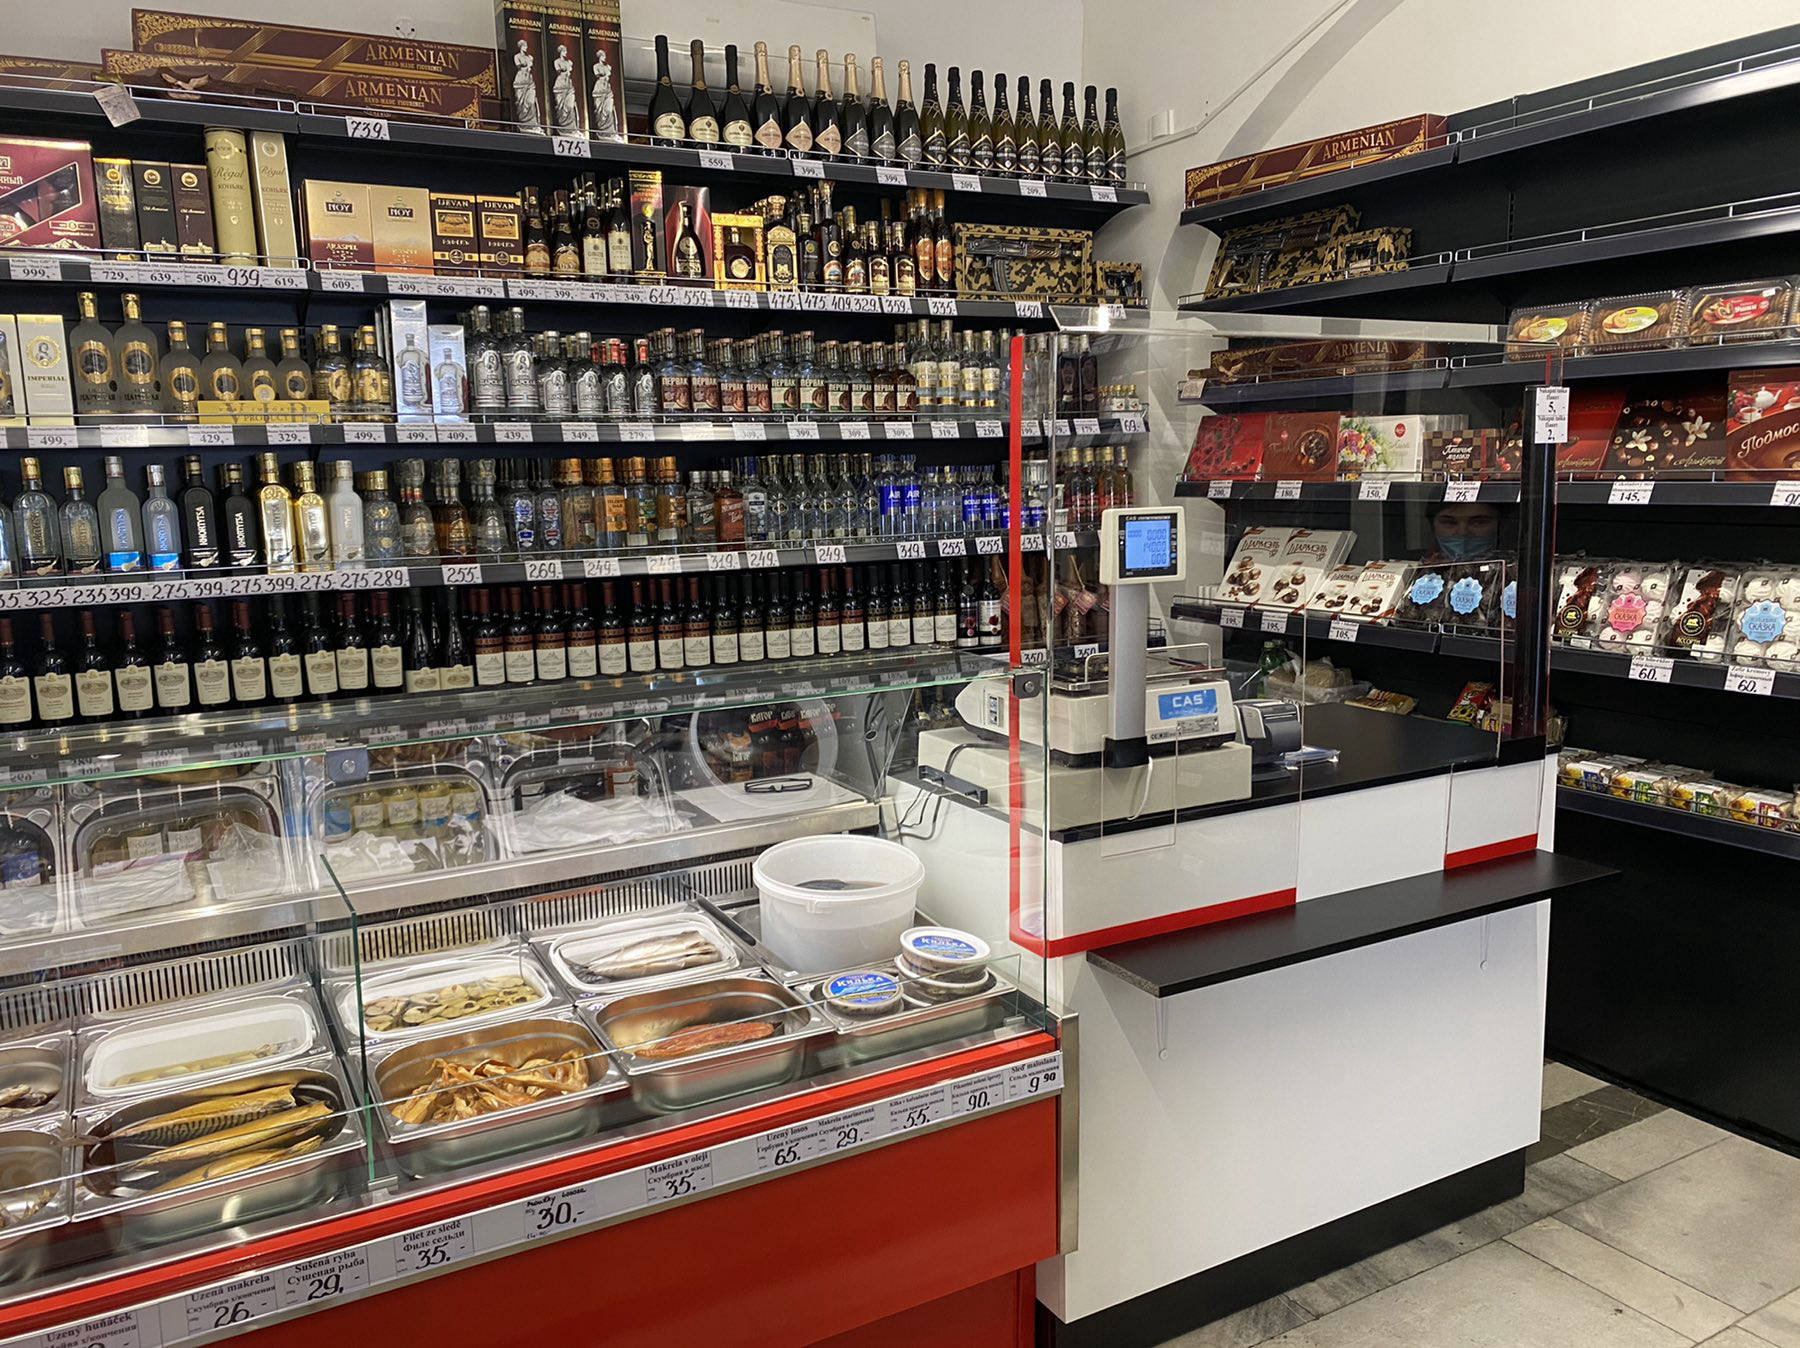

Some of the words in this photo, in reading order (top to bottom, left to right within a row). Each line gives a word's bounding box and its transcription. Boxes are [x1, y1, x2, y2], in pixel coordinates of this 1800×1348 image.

[508, 16, 542, 29] ARMENIAN
[548, 21, 581, 34] ARMENIAN
[588, 26, 620, 38] ARMENIAN
[365, 43, 461, 72] ARMENIAN
[345, 77, 442, 107] ARMENIAN
[1322, 128, 1397, 162] ARMENIAN
[1171, 694, 1203, 709] CAS
[403, 1229, 426, 1244] Filet
[227, 1274, 271, 1292] makrela
